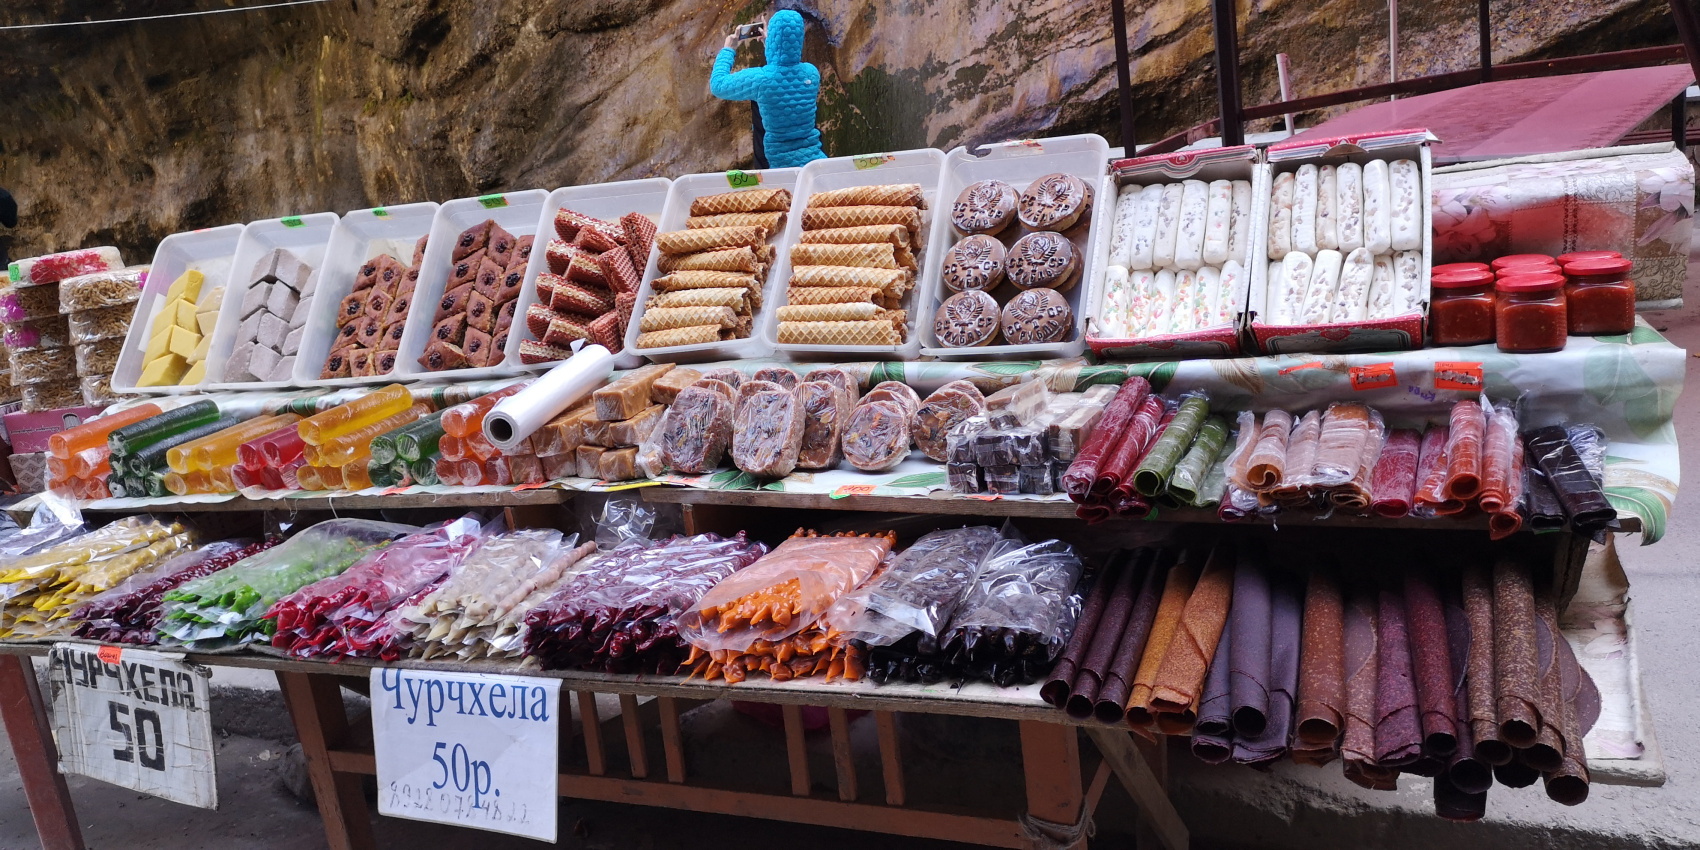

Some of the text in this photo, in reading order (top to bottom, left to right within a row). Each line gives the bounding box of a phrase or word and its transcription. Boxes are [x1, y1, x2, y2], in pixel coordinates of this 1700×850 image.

[382, 668, 550, 727] Чурчхела
[108, 701, 165, 771] 50
[432, 742, 500, 809] 50р.
